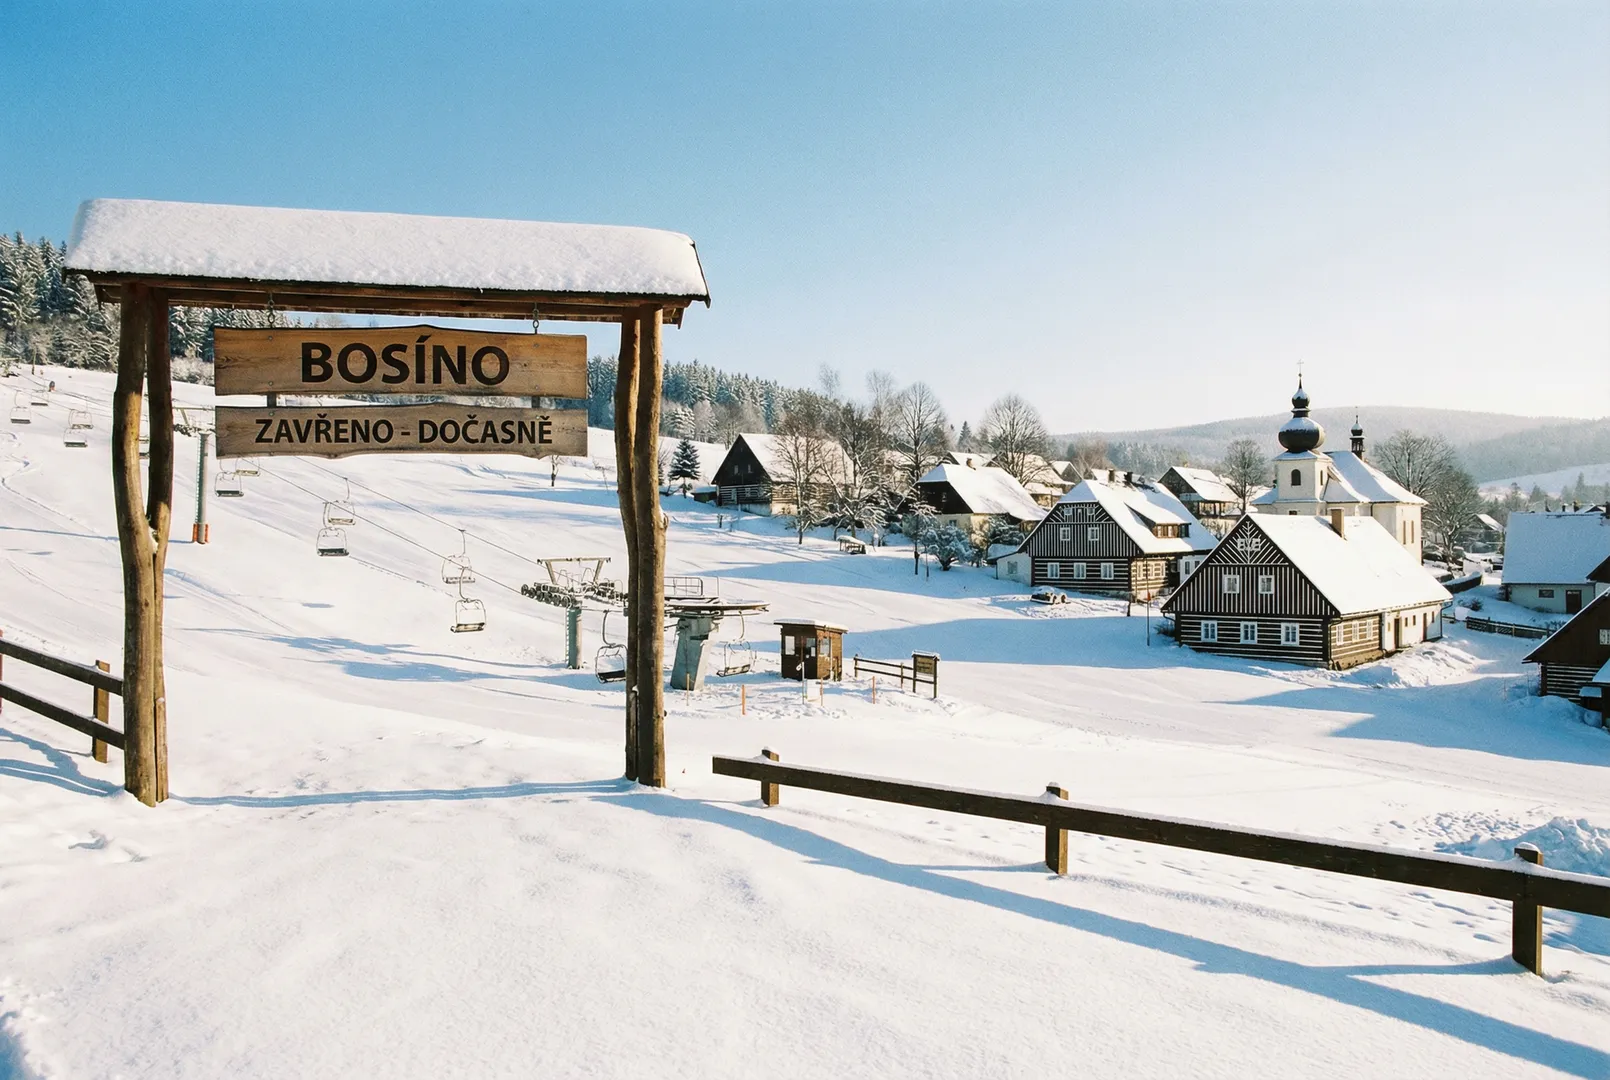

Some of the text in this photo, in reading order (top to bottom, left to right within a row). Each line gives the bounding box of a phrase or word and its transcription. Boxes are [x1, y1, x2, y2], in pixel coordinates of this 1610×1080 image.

[302, 335, 510, 386] BOSÍNO
[255, 413, 393, 444] ZAVŘENO
[419, 414, 553, 444] DOČASNĚ
